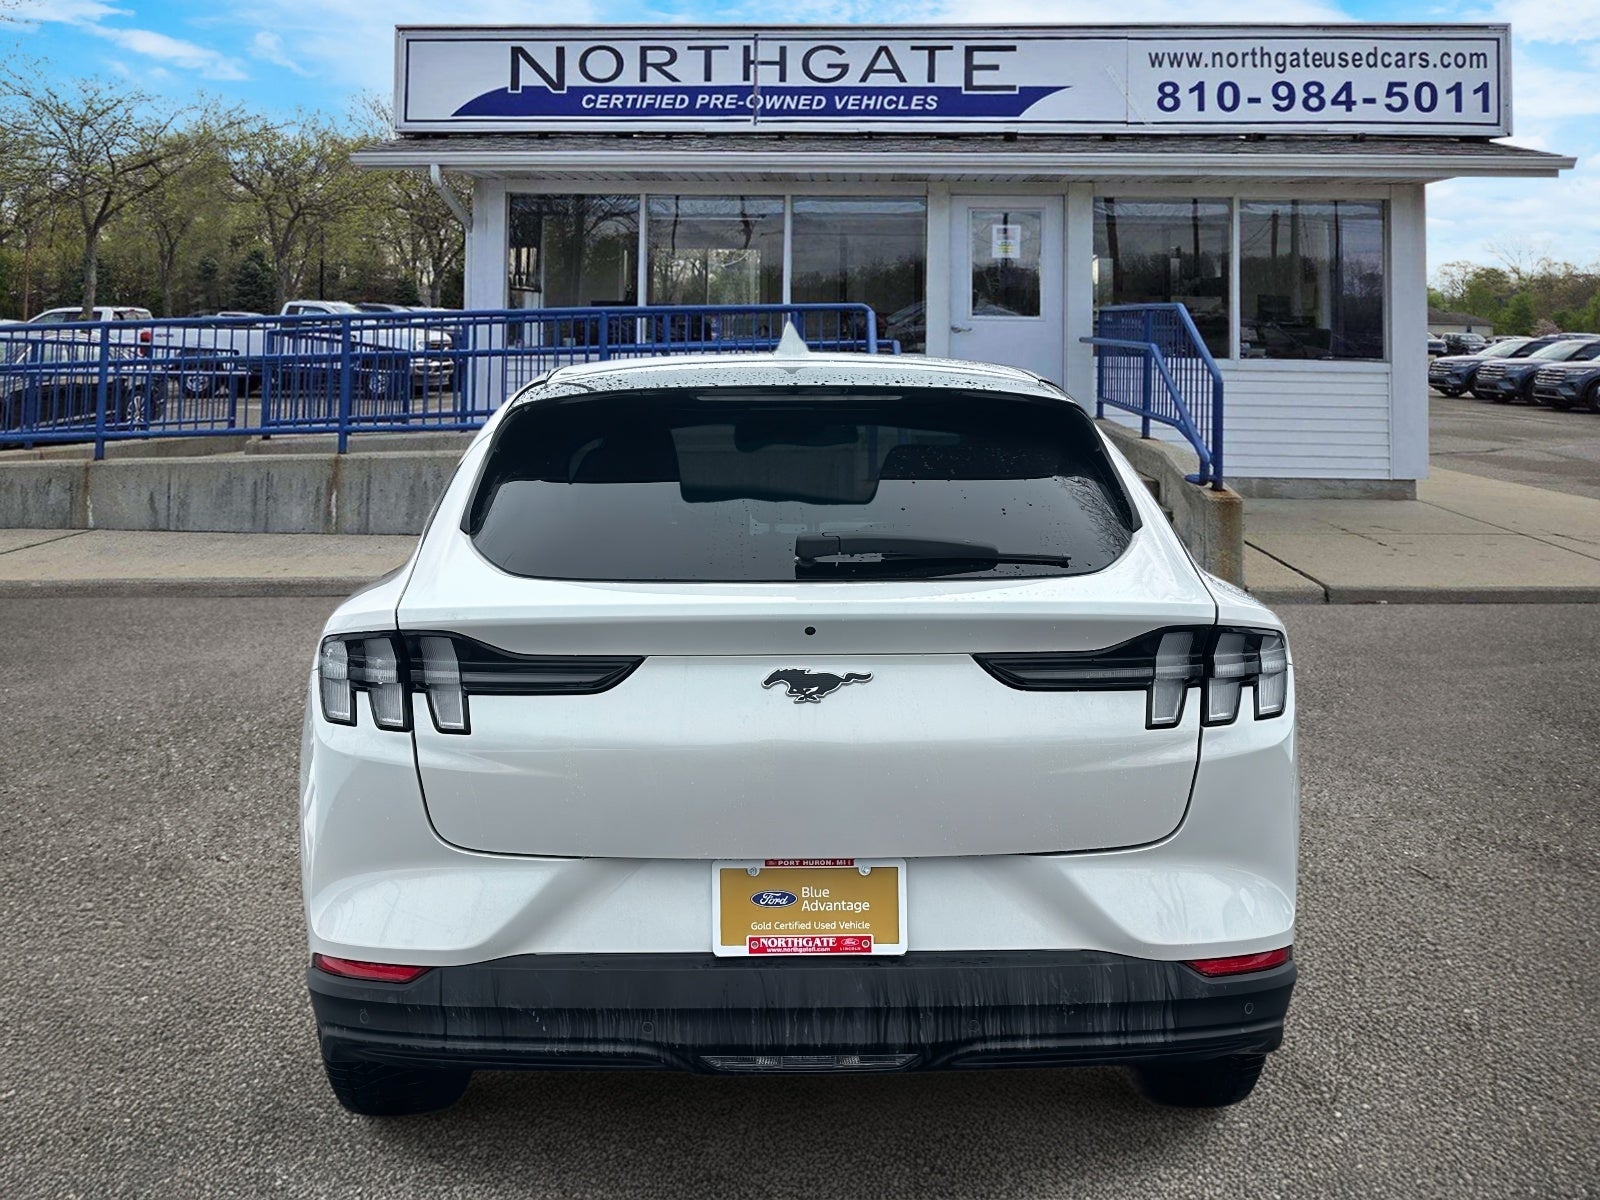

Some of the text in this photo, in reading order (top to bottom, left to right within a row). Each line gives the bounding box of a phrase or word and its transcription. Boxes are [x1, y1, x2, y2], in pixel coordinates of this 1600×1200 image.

[1148, 46, 1489, 74] www.northgateusedcars.com
[509, 44, 1018, 93] NORTHGATE
[581, 94, 939, 110] CERTIFIED PRE-OWNED VEHICLES
[1157, 80, 1491, 113] 810-984-5011
[759, 892, 789, 905] Ford
[801, 886, 830, 898] Blue
[801, 900, 870, 913] Advantage
[751, 921, 870, 930] Gold Certified Used Vehicle
[760, 937, 837, 947] NORTHGATE
